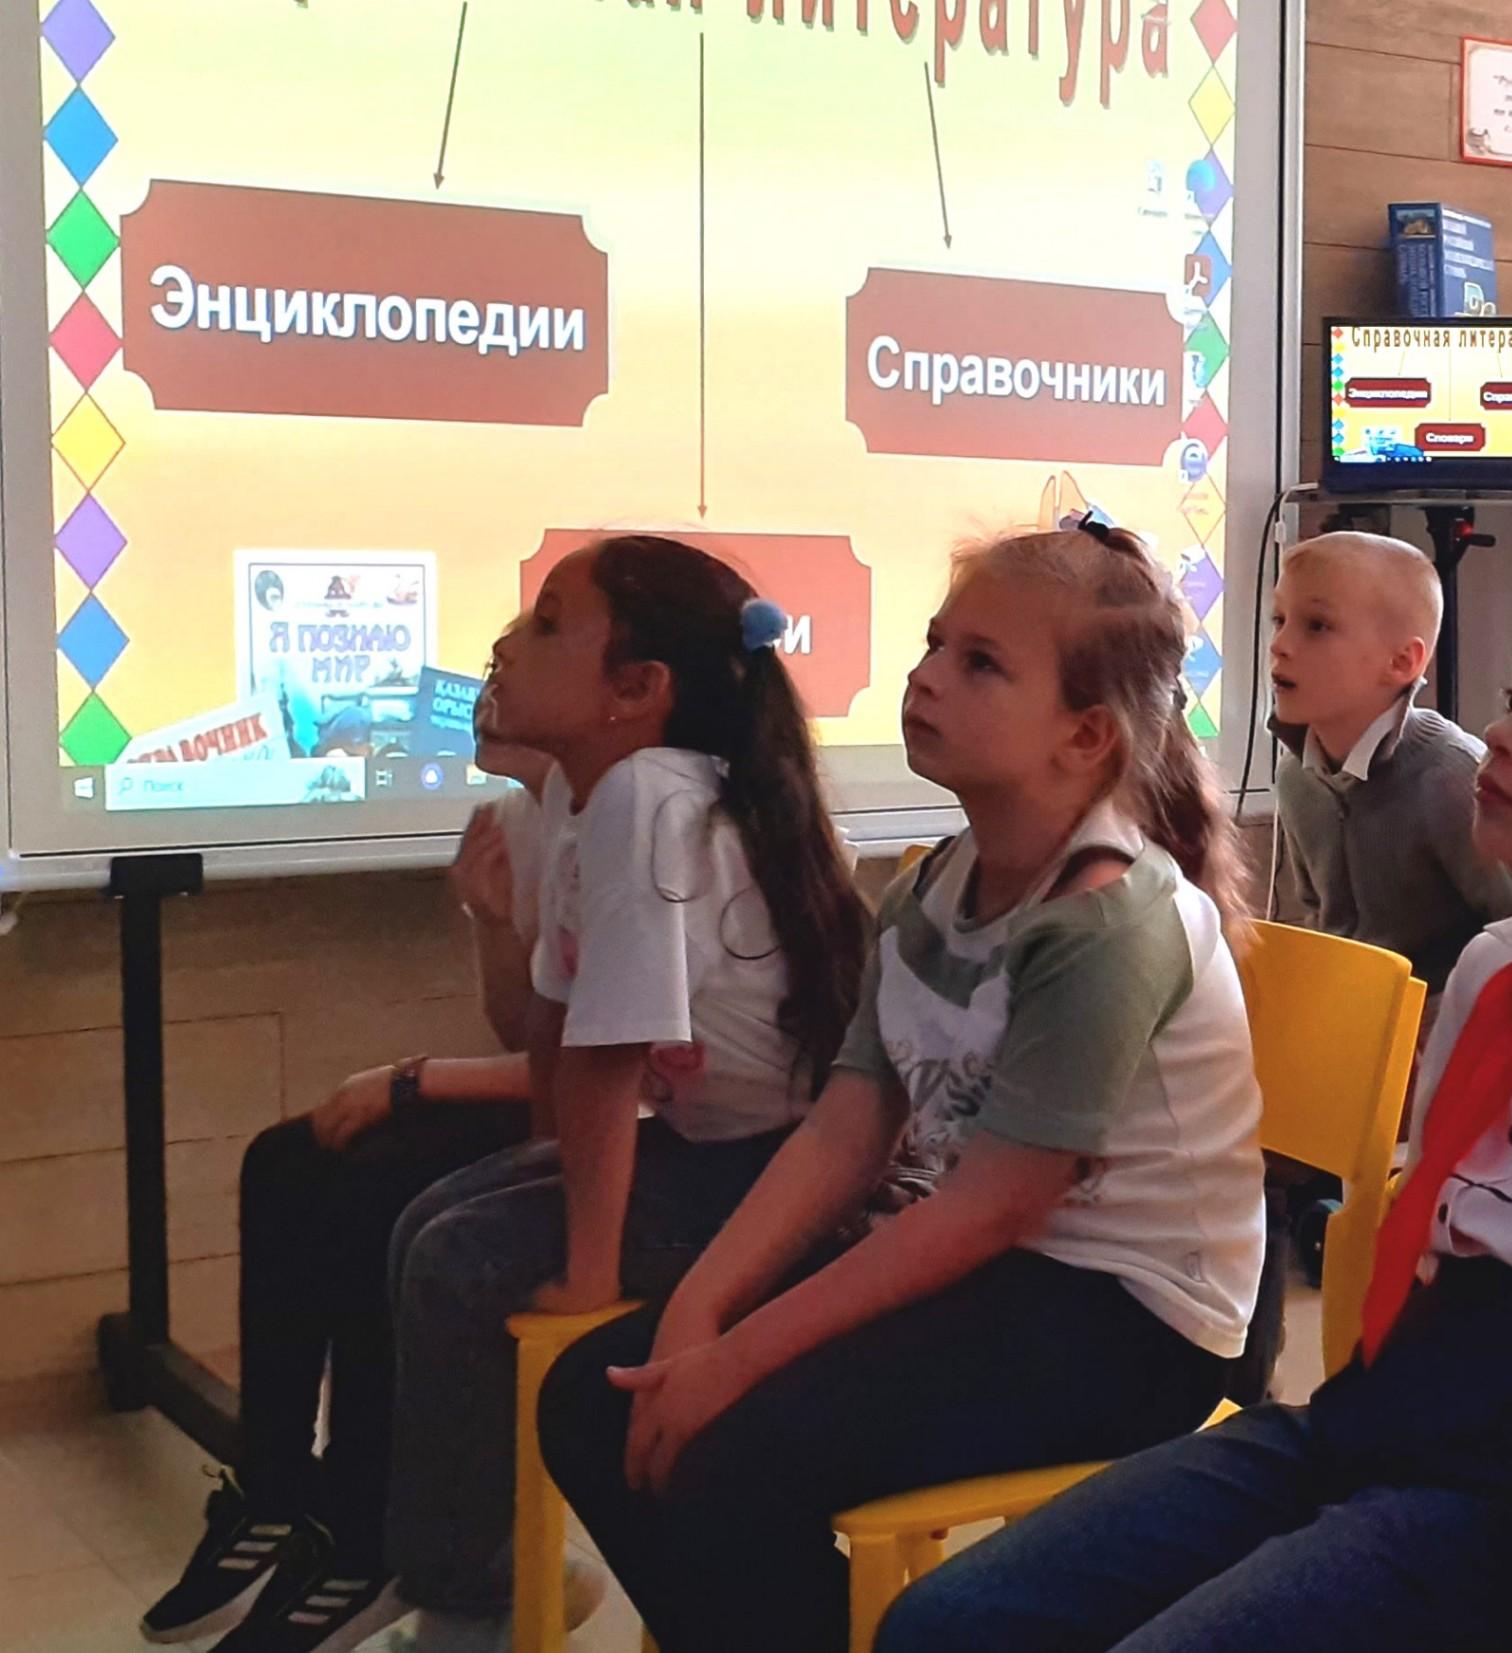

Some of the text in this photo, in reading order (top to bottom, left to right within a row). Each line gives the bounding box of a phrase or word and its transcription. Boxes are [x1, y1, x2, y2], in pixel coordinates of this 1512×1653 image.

[746, 0, 1168, 108] ратура
[150, 265, 586, 355] Энциклопедии
[1351, 326, 1450, 353] Справочная
[867, 335, 1166, 406] Справочники
[268, 620, 412, 653] Я ПОЗНАЮ
[310, 654, 371, 684] МИР
